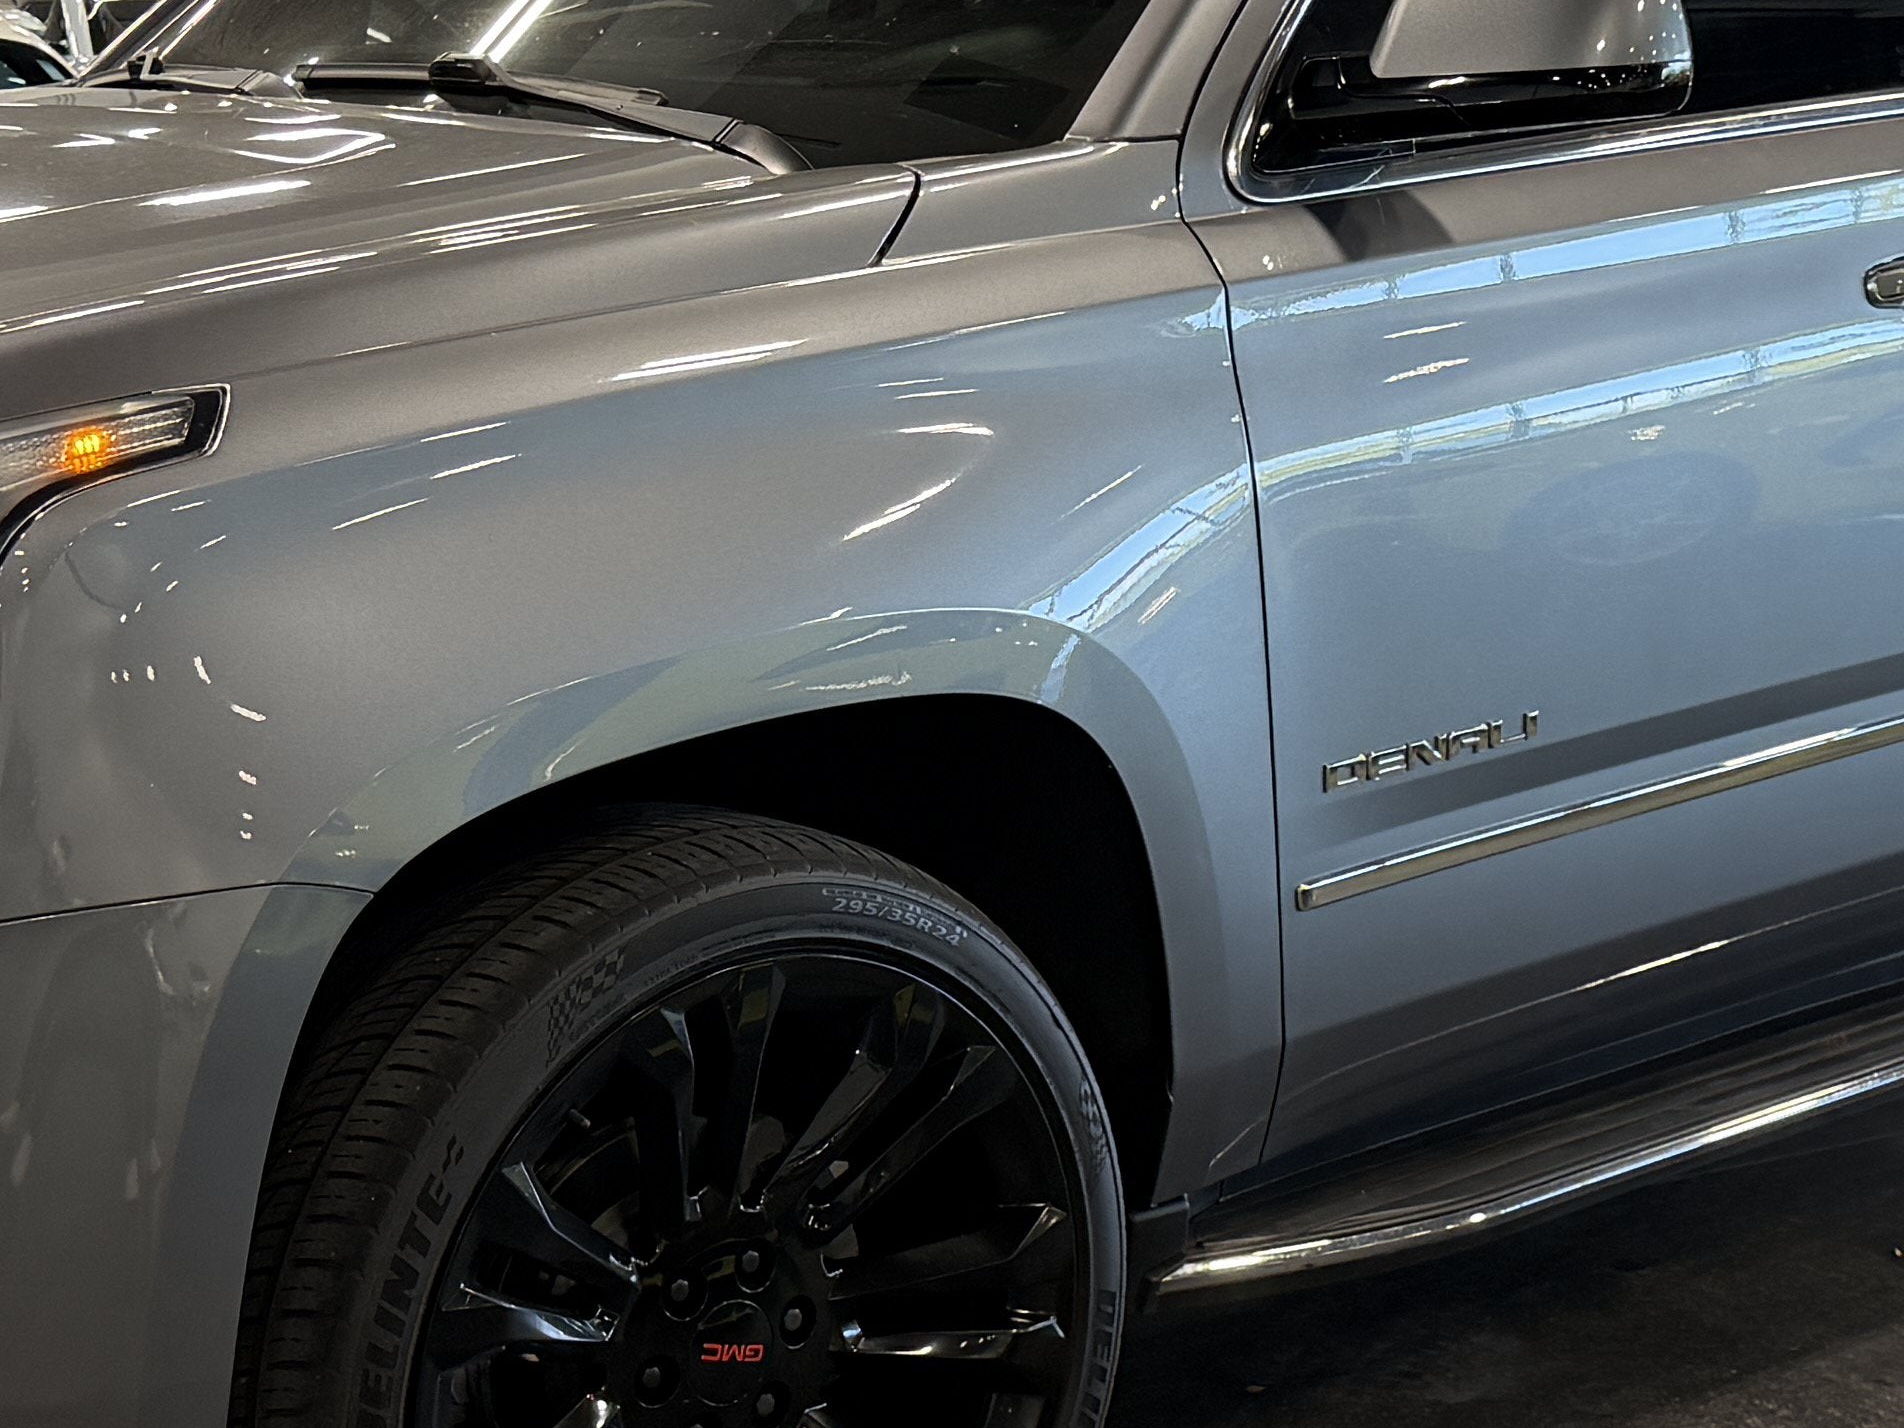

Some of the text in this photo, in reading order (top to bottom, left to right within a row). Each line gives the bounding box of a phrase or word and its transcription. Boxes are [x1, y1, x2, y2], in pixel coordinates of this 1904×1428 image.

[1321, 709, 1540, 794] DENALI
[831, 897, 962, 947] 295/35R24
[700, 1342, 765, 1363] GMC
